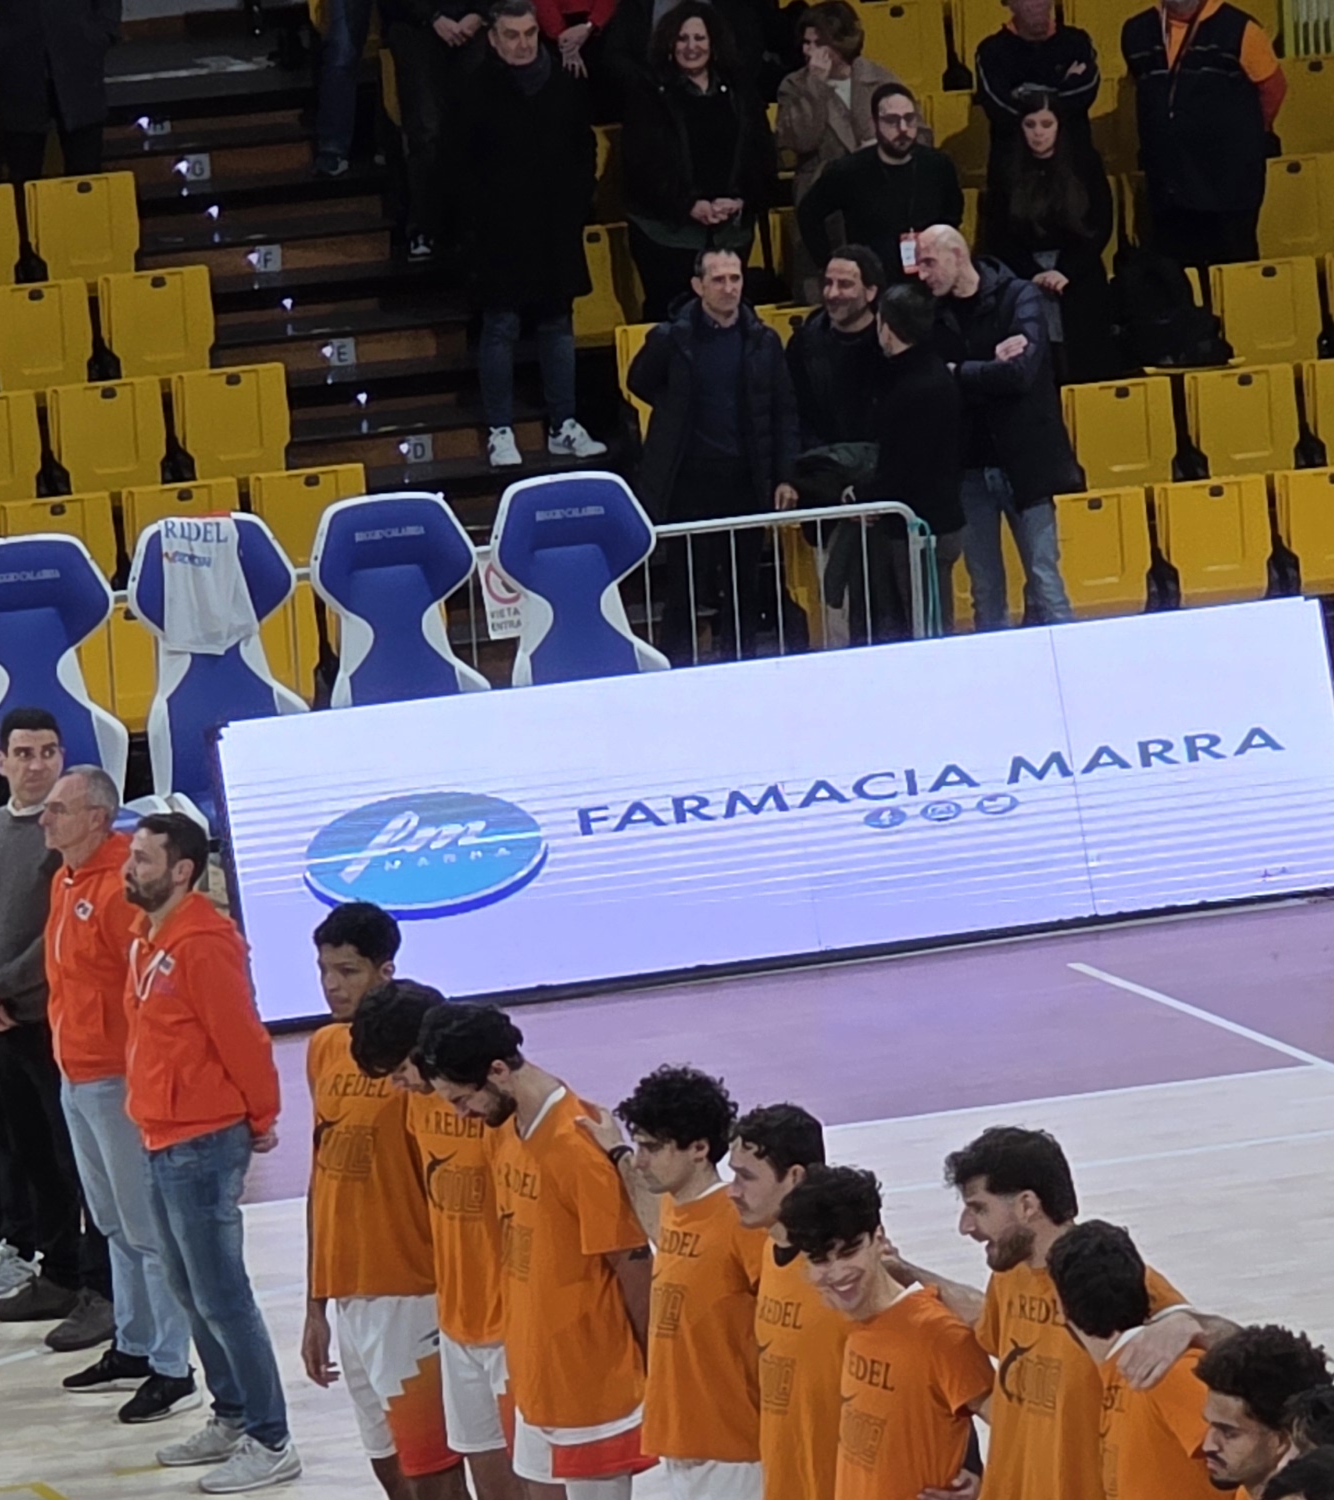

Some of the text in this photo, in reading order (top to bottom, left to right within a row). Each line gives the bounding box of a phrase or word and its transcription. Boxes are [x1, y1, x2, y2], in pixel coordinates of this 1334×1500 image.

[263, 252, 273, 266] F
[336, 344, 348, 363] E
[413, 442, 426, 460] D
[490, 607, 521, 619] VIETA
[491, 619, 522, 632] ENTRA
[577, 726, 1285, 836] FARMACIA MARRA
[328, 1073, 392, 1098] REDEL
[848, 1352, 895, 1392] EDEL
